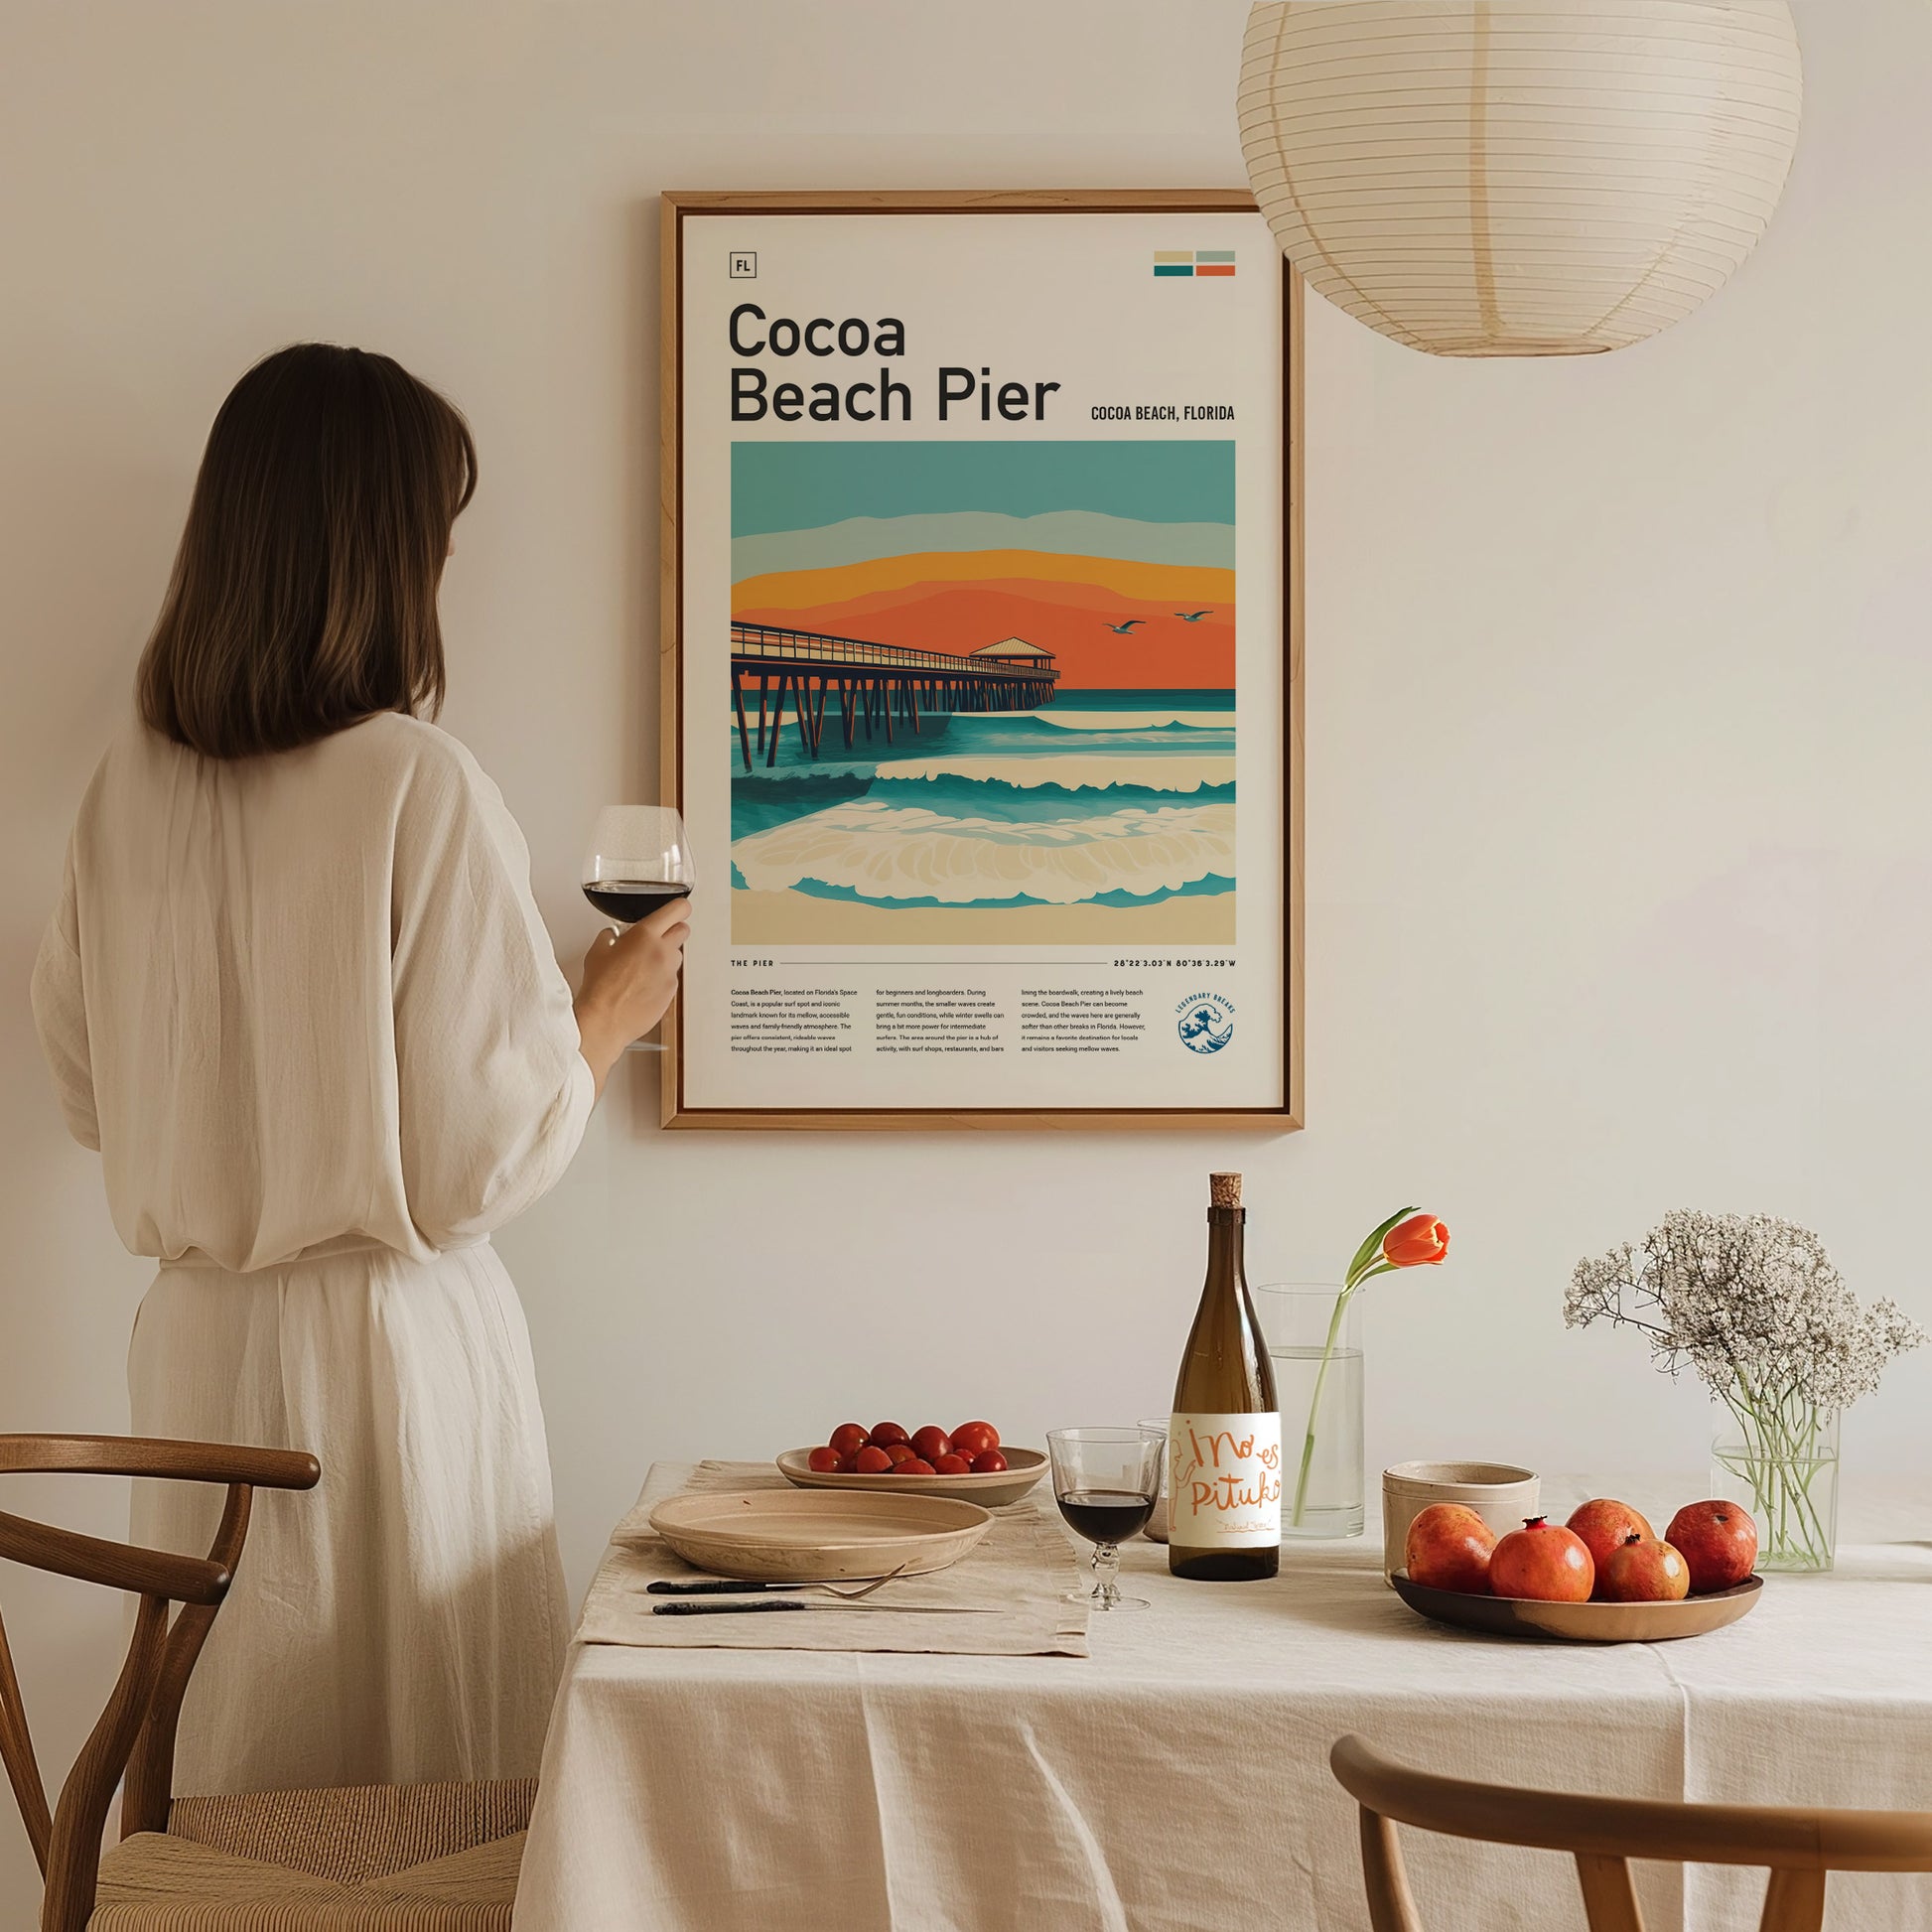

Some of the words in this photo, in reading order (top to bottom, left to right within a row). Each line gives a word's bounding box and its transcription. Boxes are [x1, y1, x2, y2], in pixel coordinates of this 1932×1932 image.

[737, 260, 751, 271] FL
[730, 303, 904, 357] Cocoa
[731, 367, 911, 421] Beach
[939, 367, 1061, 421] Pier
[1092, 406, 1131, 420] COCOA
[1136, 406, 1179, 422] BEACH,
[1184, 406, 1234, 420] FLORIDA
[769, 989, 782, 998] Pier,
[840, 989, 857, 998] Space
[886, 989, 913, 998] beginners
[927, 989, 964, 998] longboarders.
[967, 989, 986, 998] During
[1022, 989, 1036, 998] lining
[1049, 989, 1079, 998] boardwalk,
[1080, 989, 1104, 998] creating
[1110, 989, 1124, 998] lively
[1175, 993, 1210, 1013] LEGENDARY
[1213, 994, 1235, 1014] BREAKS
[762, 1023, 802, 1032] family-friendly
[803, 1023, 838, 1032] atmosphere.
[877, 1023, 891, 1032] bring
[1120, 1023, 1146, 1032] However,
[1256, 1444, 1278, 1469] es
